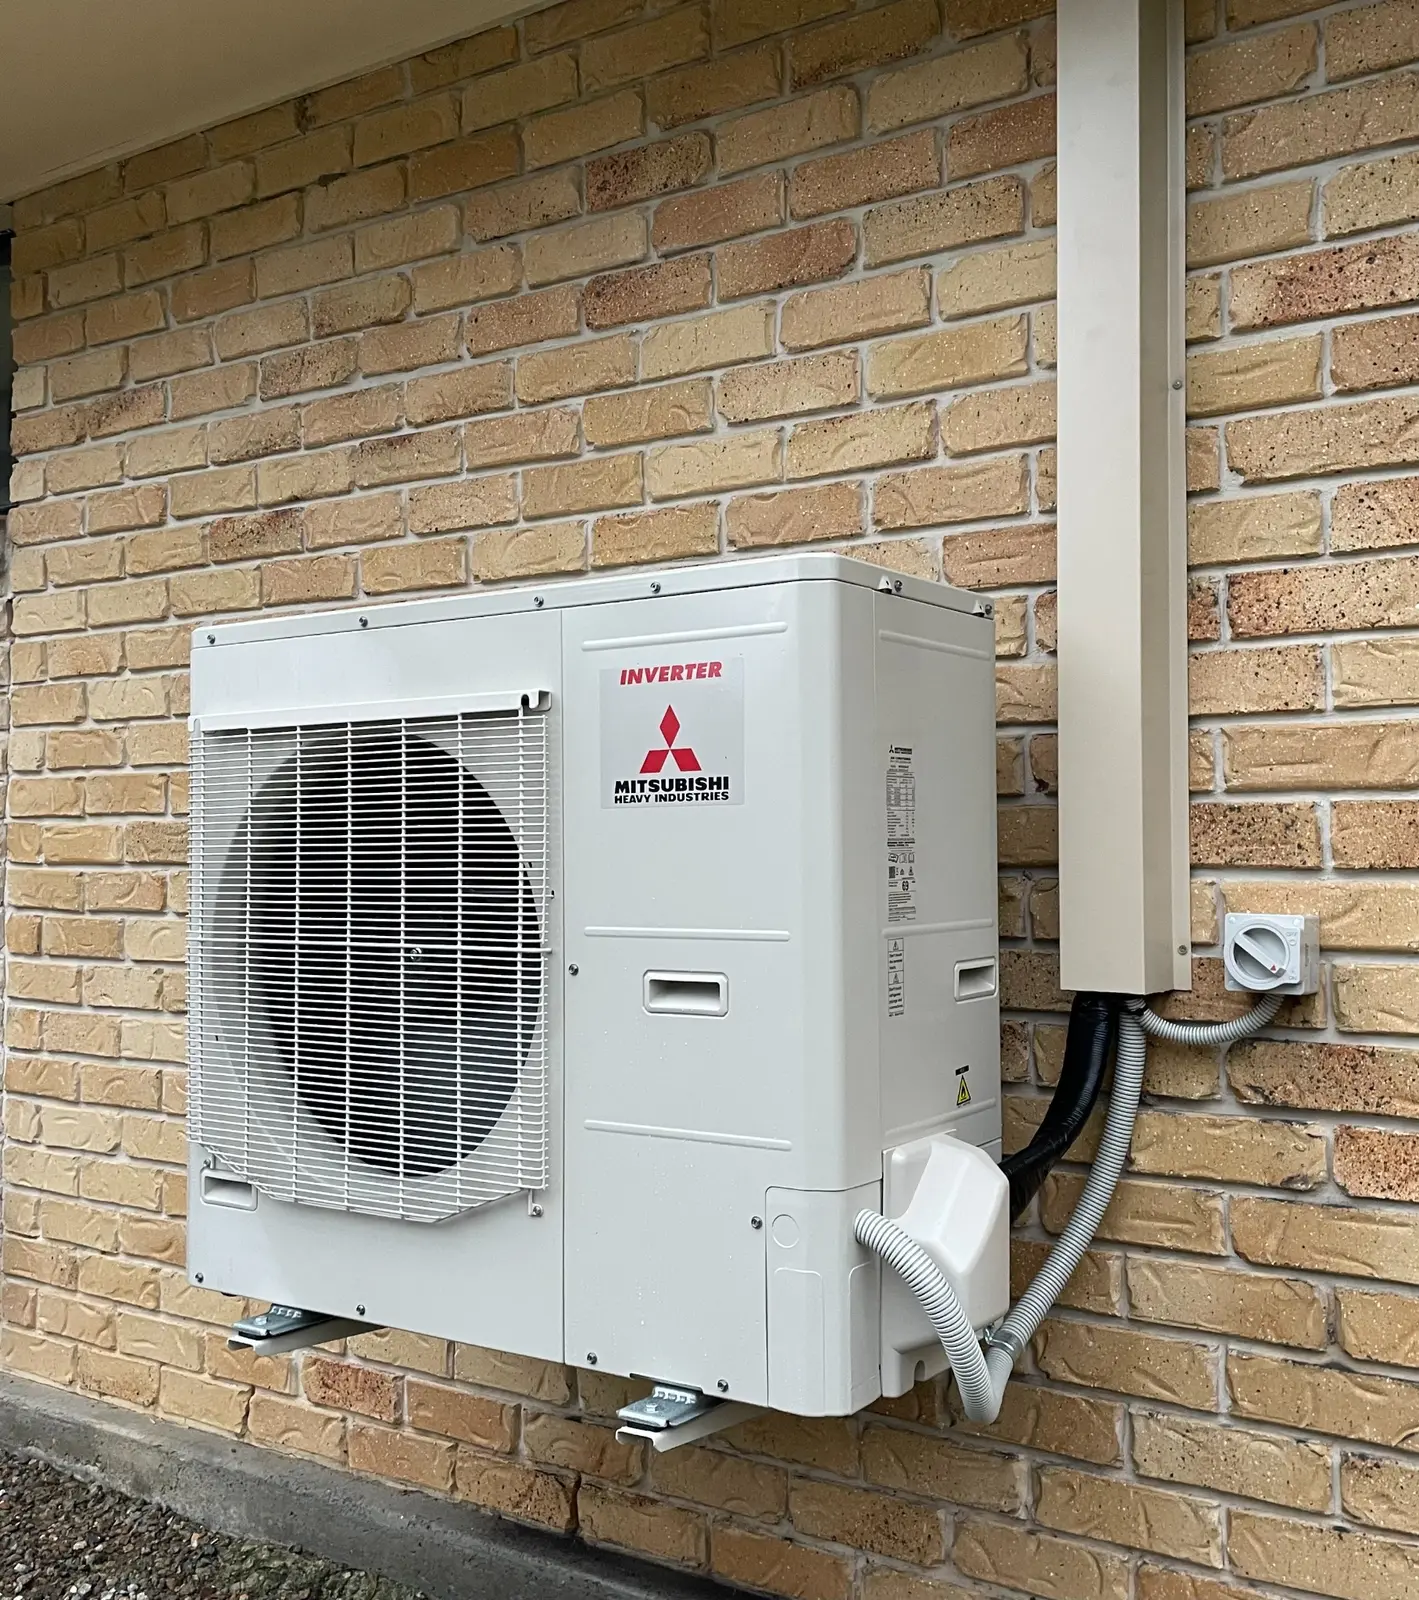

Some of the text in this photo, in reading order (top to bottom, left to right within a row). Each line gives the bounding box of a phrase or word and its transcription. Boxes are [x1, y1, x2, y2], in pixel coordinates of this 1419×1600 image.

[620, 661, 722, 685] INVERTER
[614, 776, 729, 794] MITSUBISHI
[614, 791, 729, 804] HEAVY INDUSTRIES
